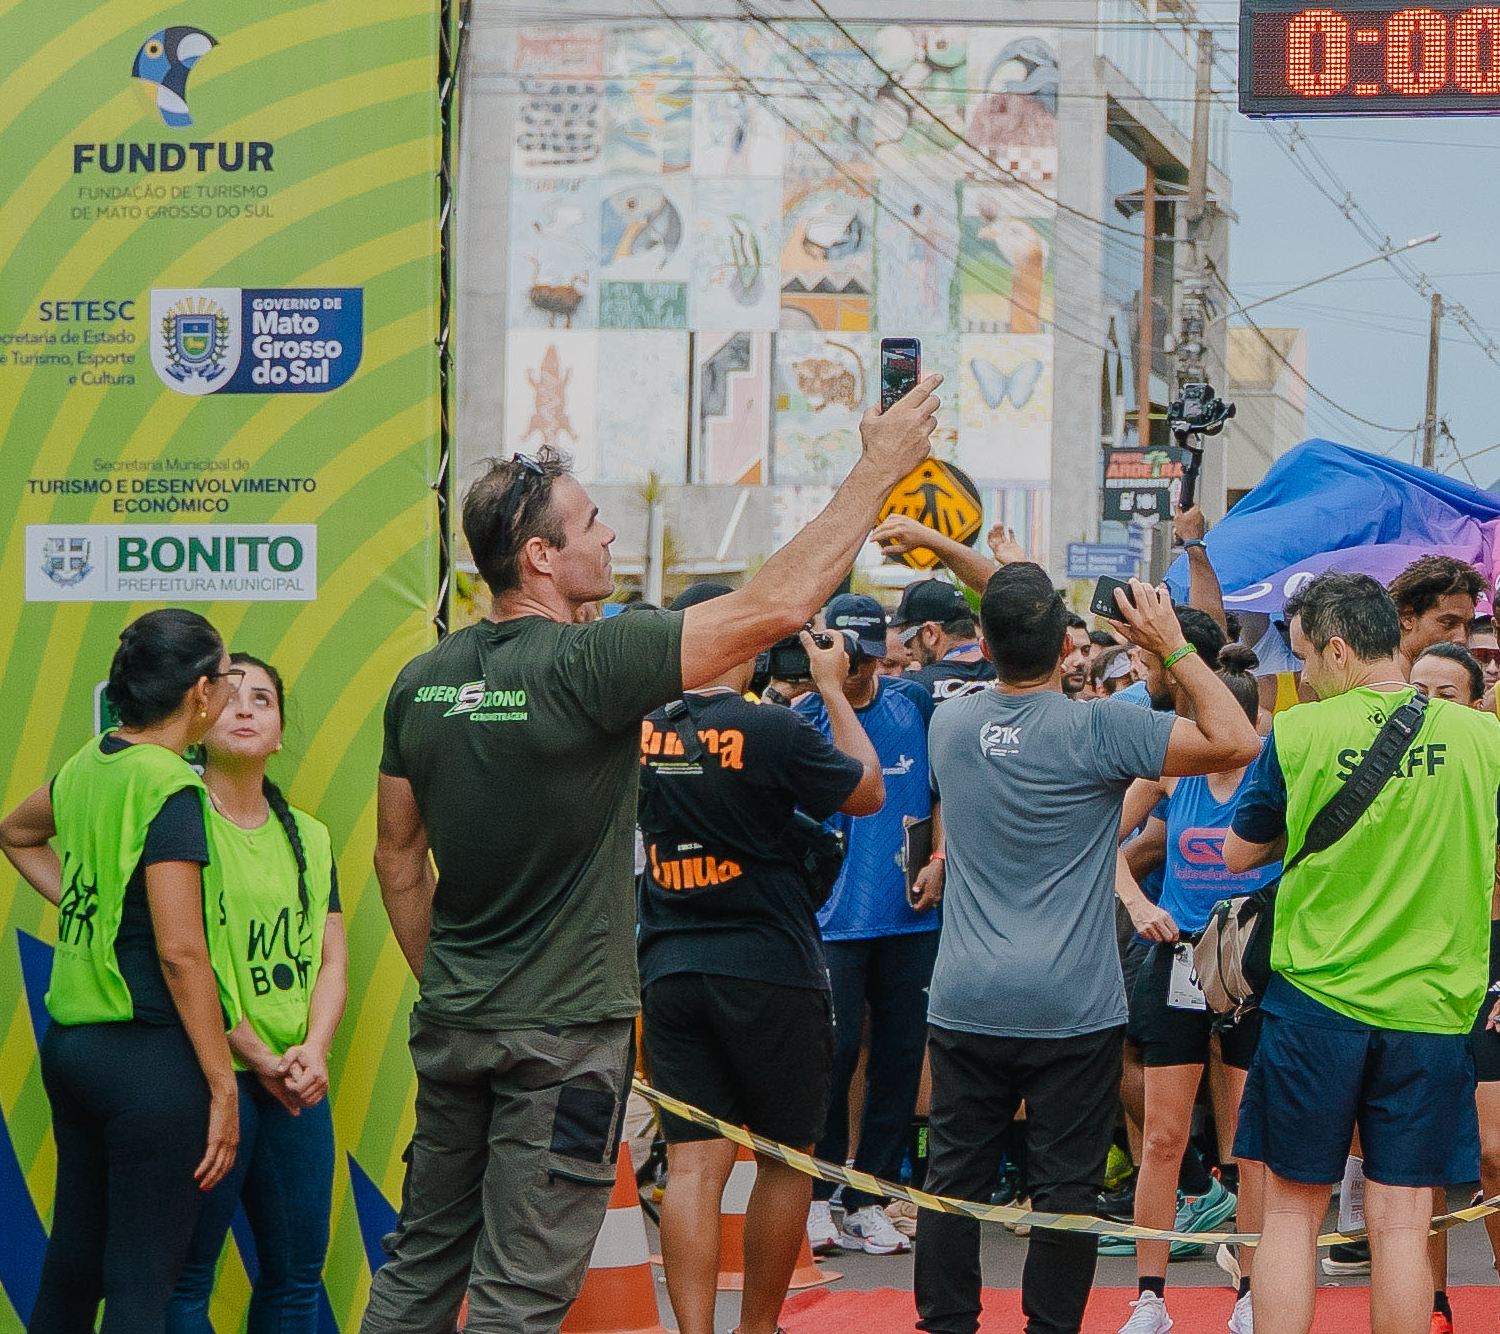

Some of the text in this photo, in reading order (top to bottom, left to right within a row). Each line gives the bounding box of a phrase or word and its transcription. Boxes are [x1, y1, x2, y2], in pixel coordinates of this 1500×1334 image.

[73, 141, 274, 174] FUNDTUR
[78, 183, 268, 201] FUNDAÇÃO DE TURISMO
[72, 204, 274, 220] DE MATO GROSSO DO SUL
[40, 300, 135, 322] SETESC
[252, 297, 342, 311] GOVERNO DE
[252, 310, 320, 335] Mato
[60, 329, 79, 345] de
[83, 329, 136, 345] Estado
[251, 335, 343, 359] Grosso
[11, 350, 74, 367] Turismo,
[77, 350, 136, 368] Esporte
[68, 371, 136, 385] e Cultura
[251, 358, 330, 384] do Sul
[92, 458, 250, 472] Secretaria Municipal de
[28, 478, 317, 494] TURISMO E DESENVOLVIMENTO
[113, 496, 230, 513] ECONÔMICO
[117, 535, 303, 573] BONITO
[117, 577, 305, 592] PREFEITURA MUNICIPAL
[987, 724, 1022, 745] 21K
[1336, 743, 1447, 782] SFF
